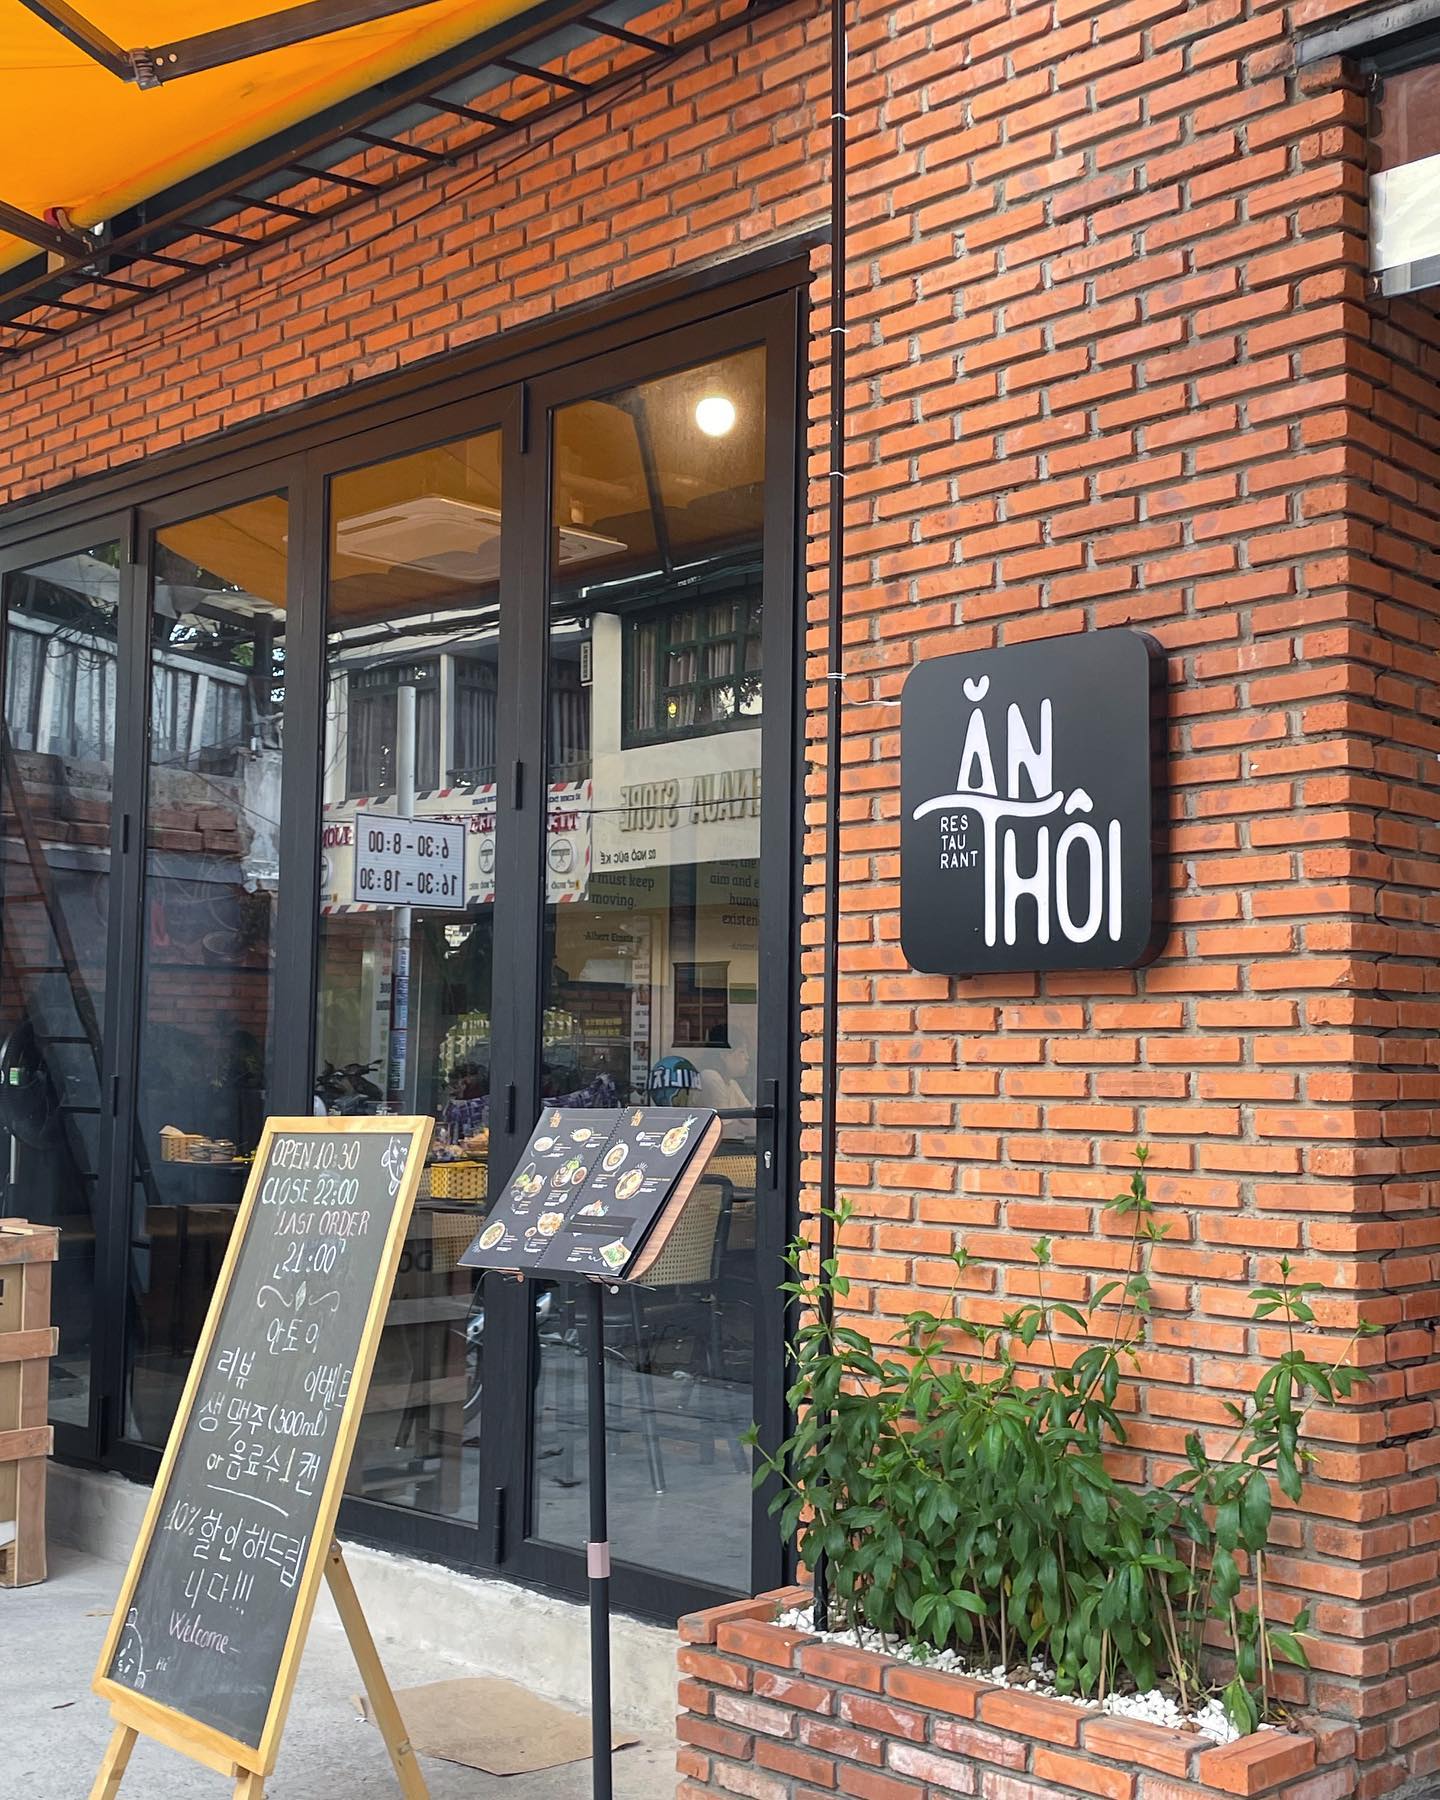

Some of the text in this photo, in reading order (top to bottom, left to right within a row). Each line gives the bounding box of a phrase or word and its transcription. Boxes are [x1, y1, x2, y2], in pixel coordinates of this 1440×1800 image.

[957, 675, 1053, 799] ĂN
[940, 814, 969, 832] RES
[941, 834, 967, 850] TAU
[940, 850, 978, 869] RANT
[628, 872, 655, 892] keep
[710, 872, 730, 885] aim
[732, 873, 752, 888] and
[271, 1138, 361, 1170] OPEN 10:30
[261, 1176, 360, 1206] CLOSE 22:00
[274, 1210, 371, 1237] LAST ORDER
[217, 1347, 256, 1389] 리뷰
[163, 1499, 202, 1537] 10%
